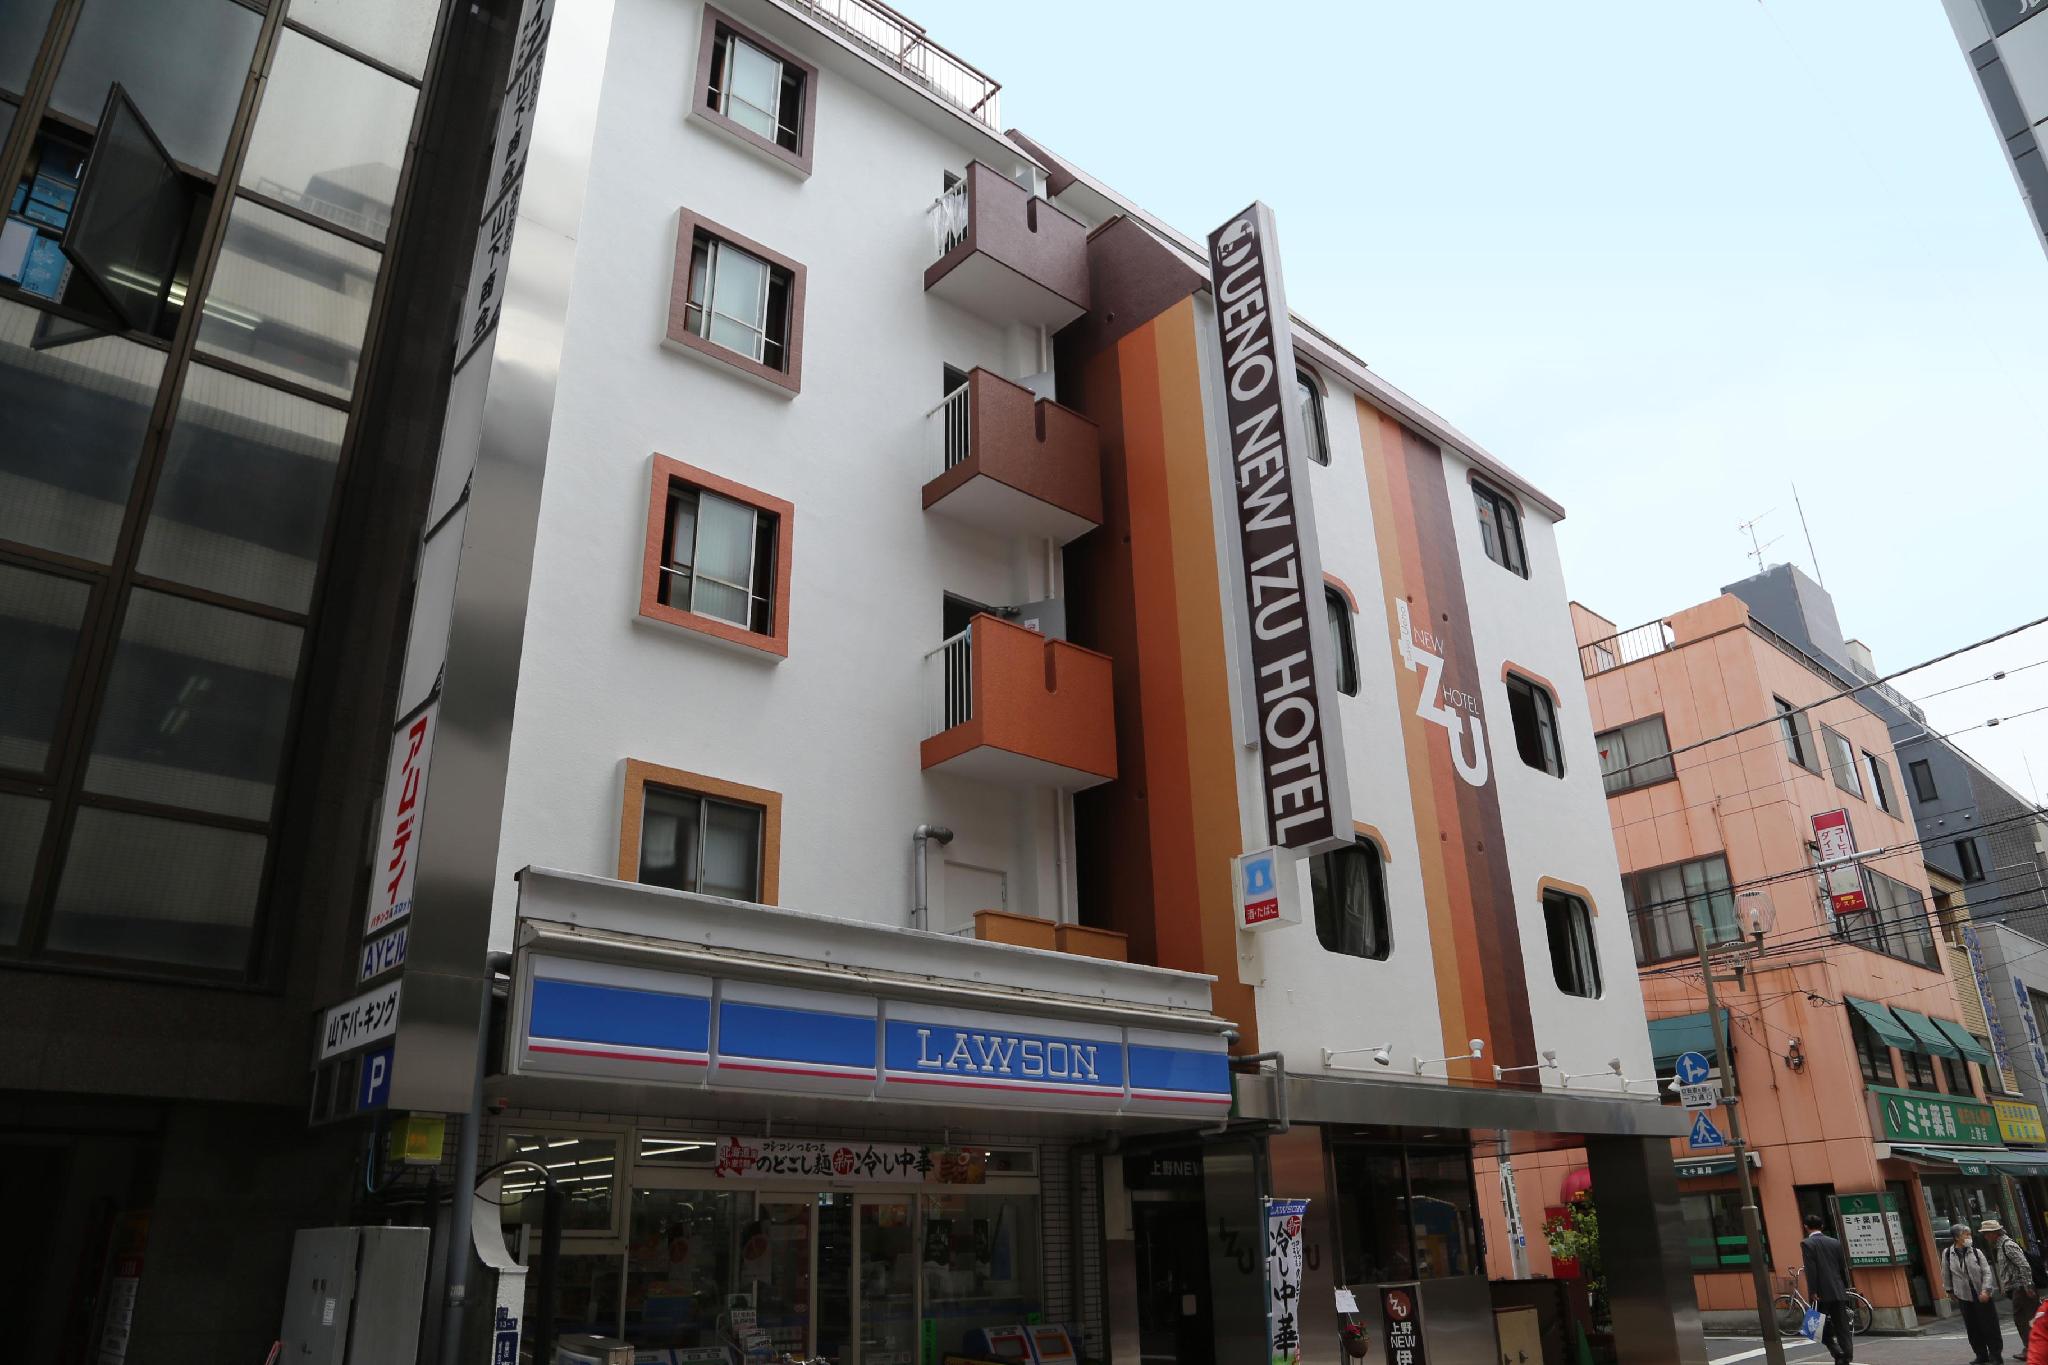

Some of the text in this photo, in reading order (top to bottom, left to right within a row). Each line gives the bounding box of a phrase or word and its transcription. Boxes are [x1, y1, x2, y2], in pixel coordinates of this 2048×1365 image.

[472, 201, 508, 343] 山下商会
[1219, 256, 1325, 846] UENO NEW IZU HOTEL
[1414, 628, 1444, 653] NEW
[1442, 684, 1480, 715] HOTEL
[388, 715, 428, 905] アムディ
[327, 990, 397, 1049] 山下パーキング
[917, 1028, 1100, 1081] LAWSON
[367, 1055, 386, 1104] P
[1904, 1100, 1957, 1138] ミキ薬局
[756, 1153, 834, 1177] のどごし麺
[854, 1144, 934, 1178] 冷し中華
[1270, 1221, 1298, 1362] 冷し中華
[1390, 1335, 1416, 1349] NEW
[1391, 1322, 1412, 1335] 上野
